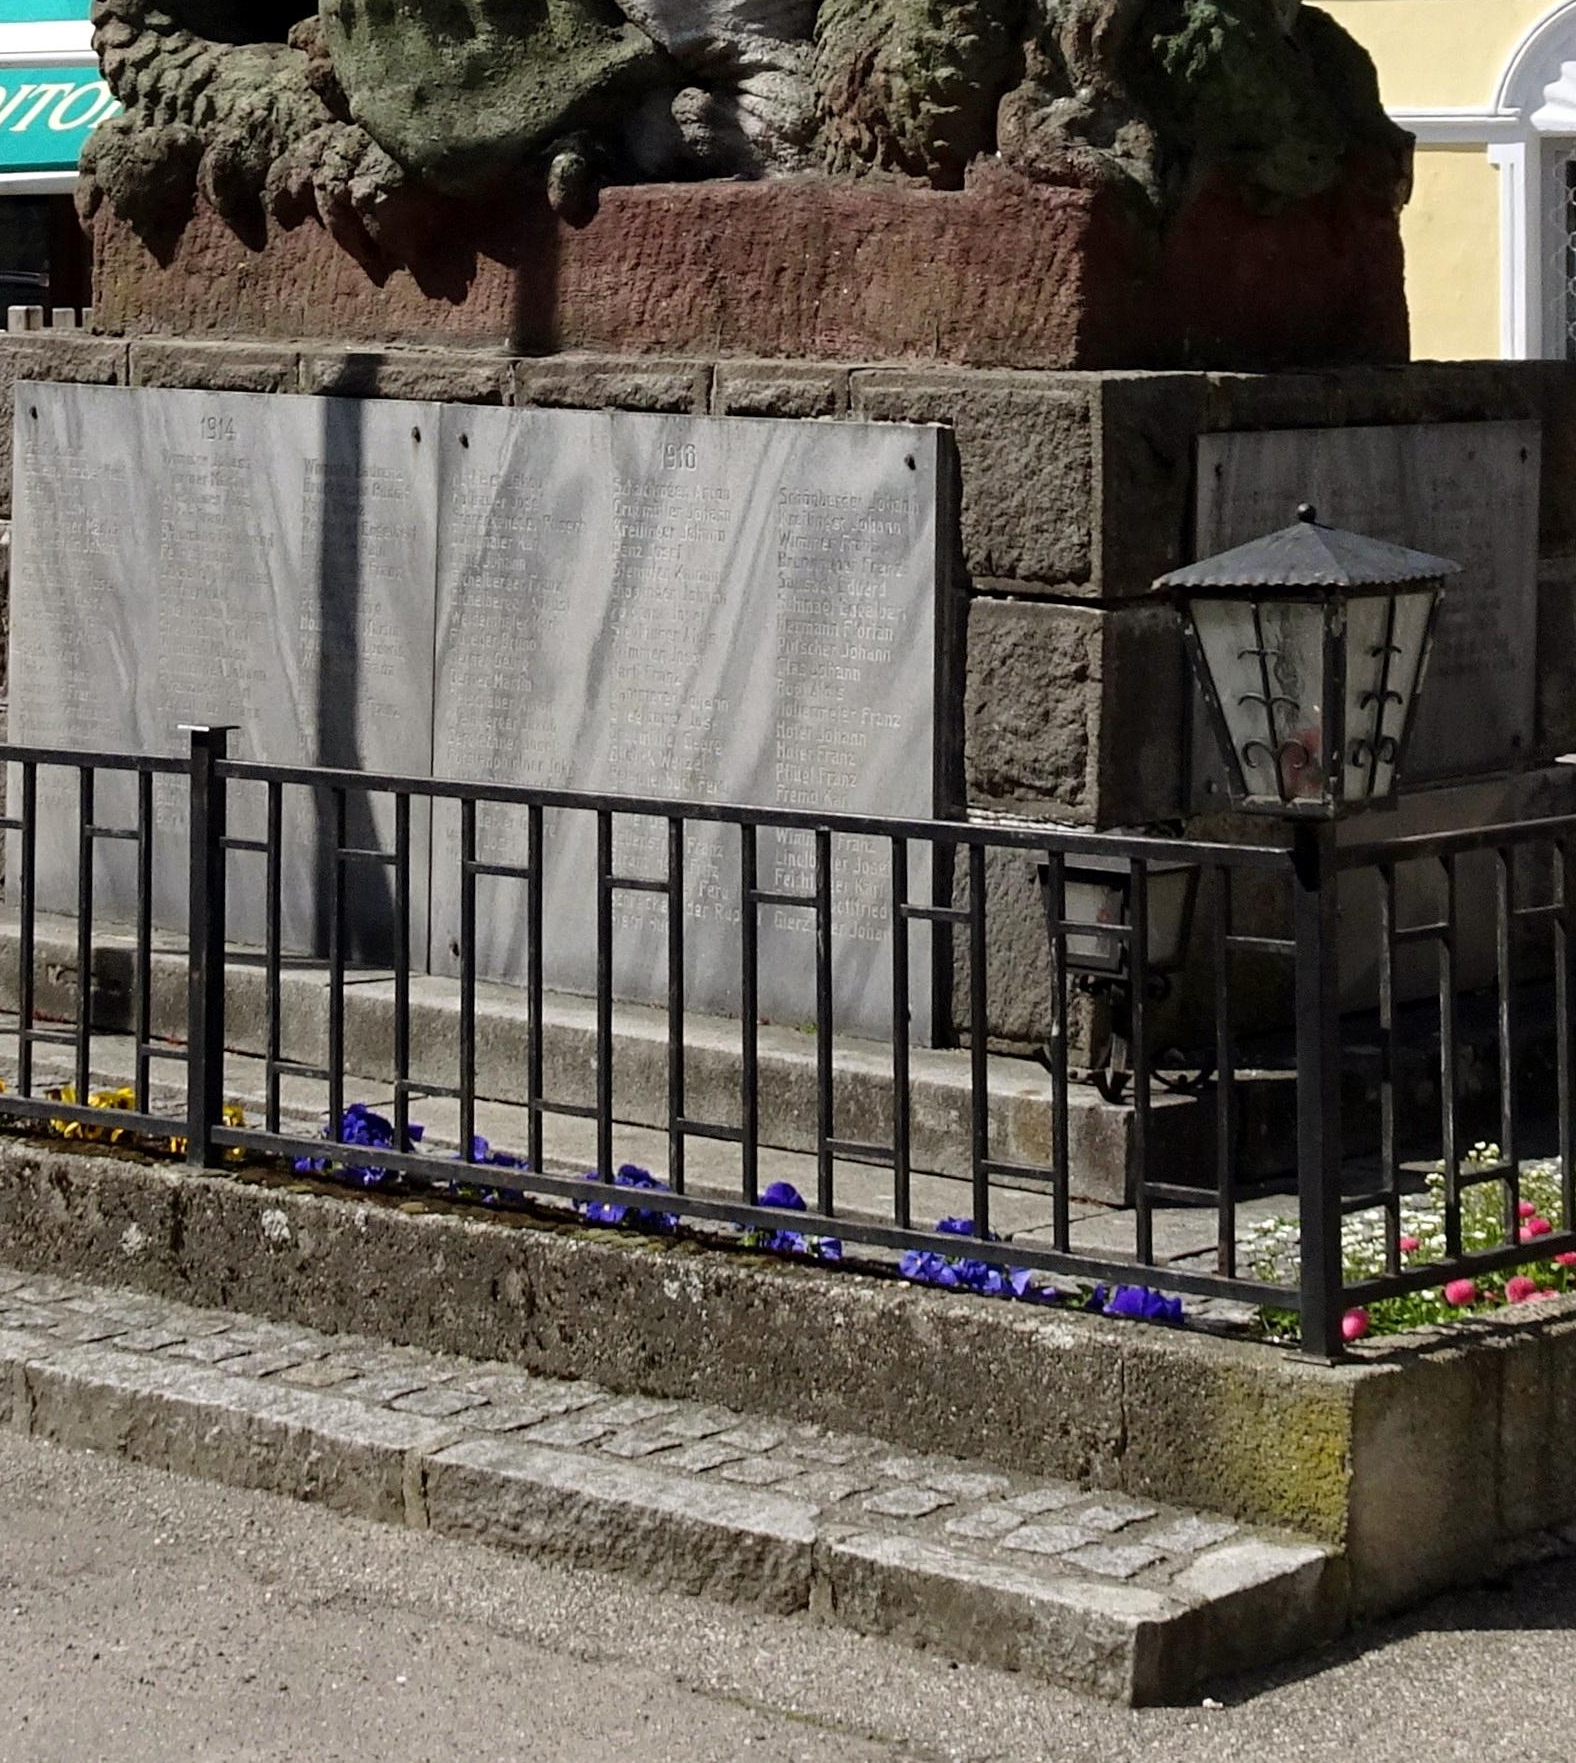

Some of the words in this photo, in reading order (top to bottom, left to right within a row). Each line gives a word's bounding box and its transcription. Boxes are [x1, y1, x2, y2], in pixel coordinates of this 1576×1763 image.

[775, 827, 816, 848] Wimm
[831, 898, 888, 920] ottfried
[849, 919, 891, 943] Johan
